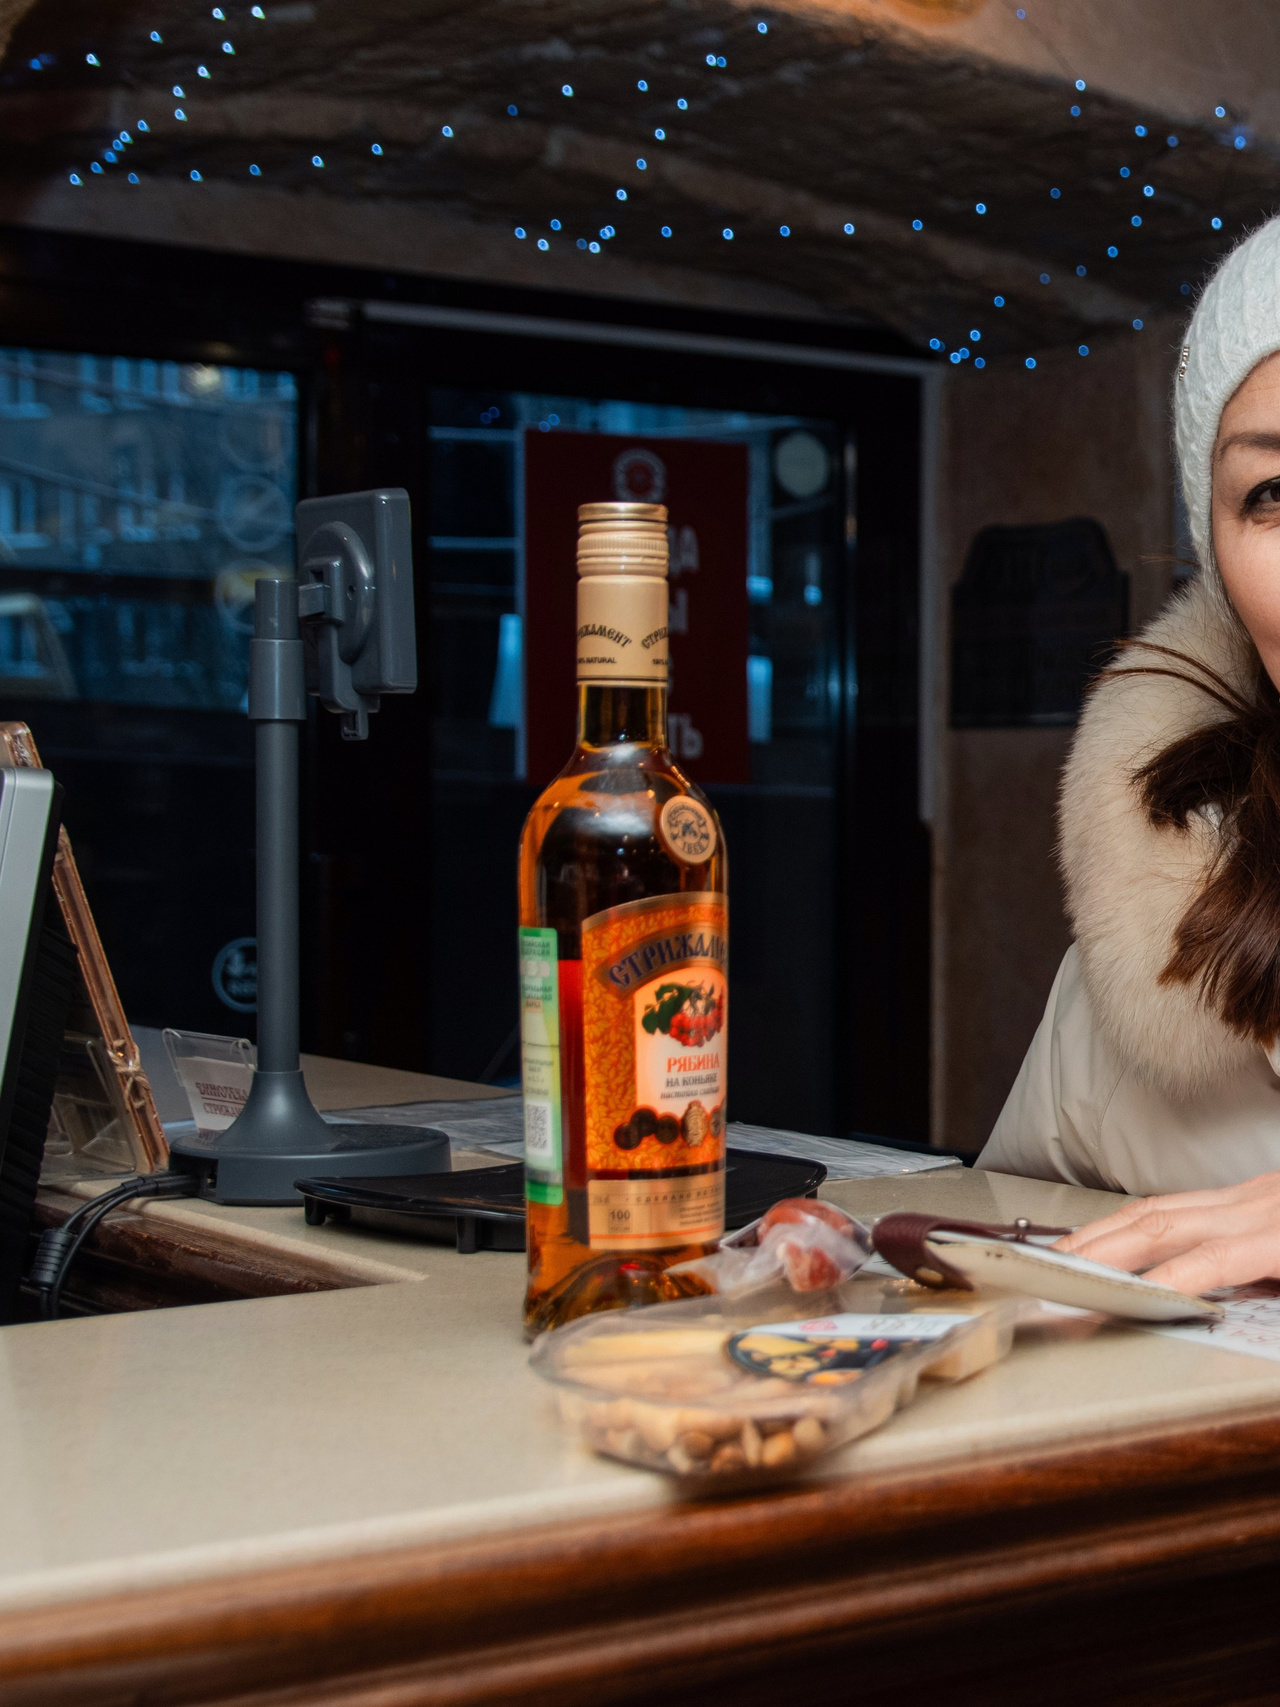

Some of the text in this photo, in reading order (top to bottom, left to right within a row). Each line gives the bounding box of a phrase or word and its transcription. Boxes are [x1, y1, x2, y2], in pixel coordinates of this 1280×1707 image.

[666, 1052, 720, 1073] РЯБИНА
[665, 1073, 718, 1087] НА КОНЬЯКЕ
[610, 1209, 631, 1220] 100
